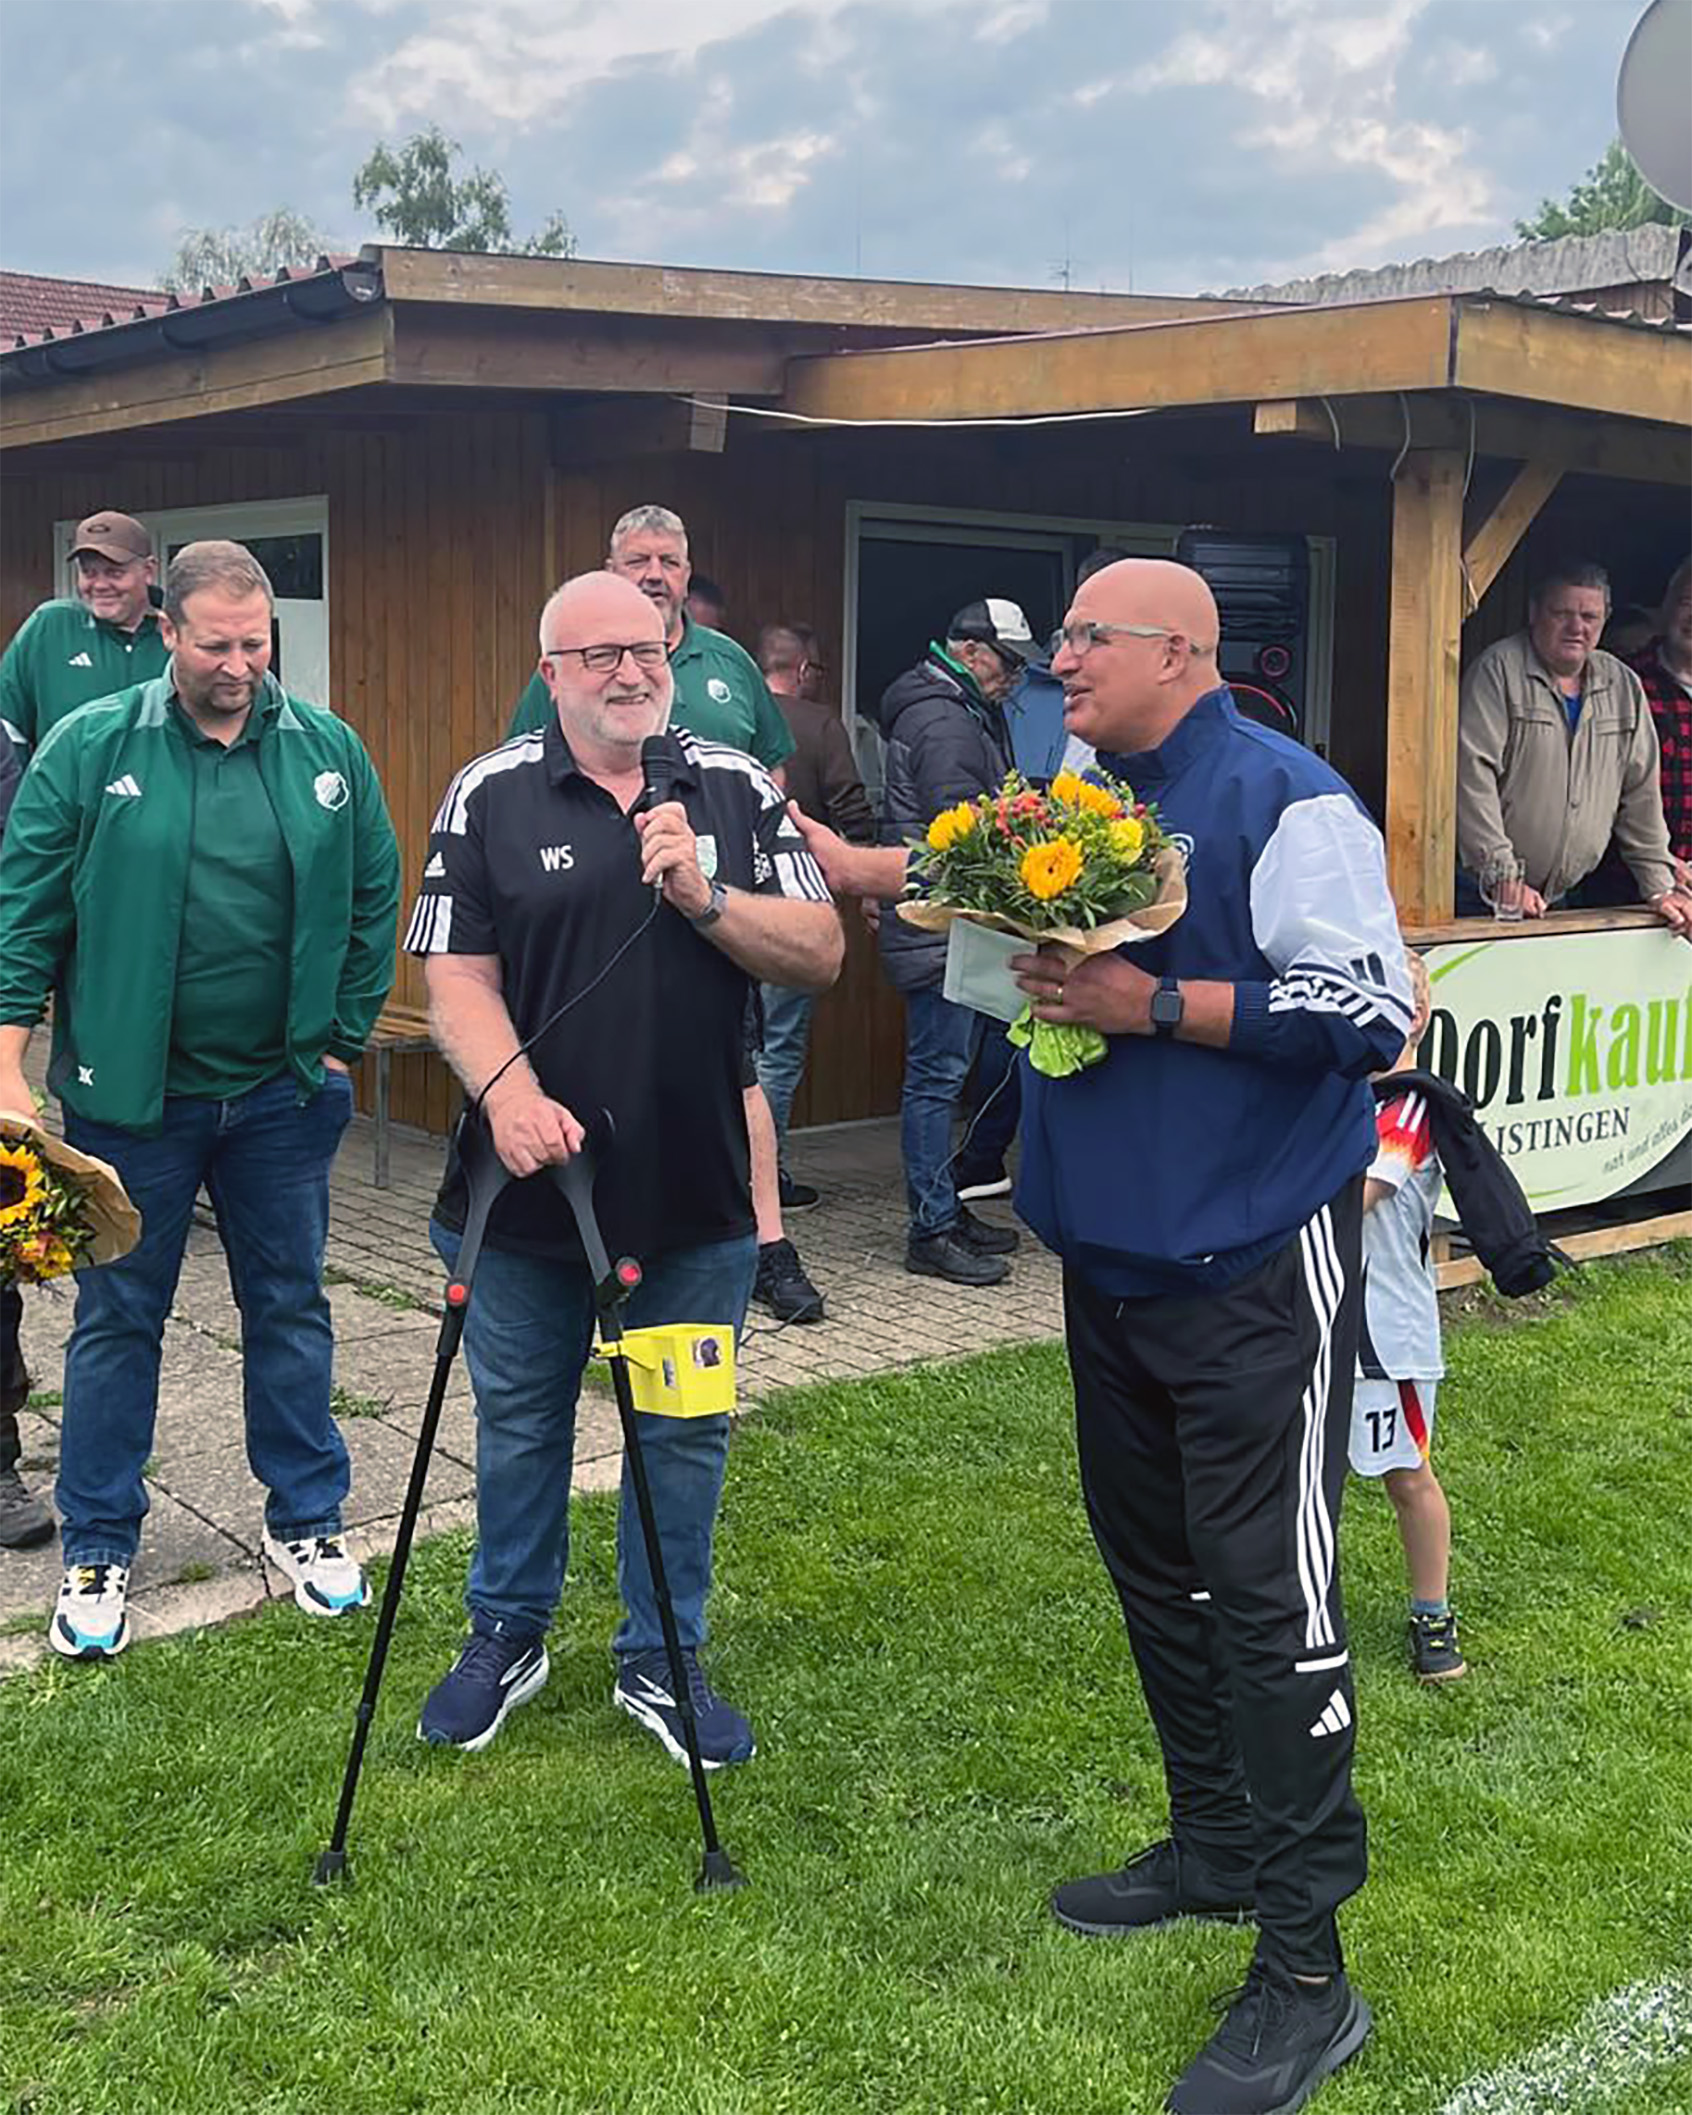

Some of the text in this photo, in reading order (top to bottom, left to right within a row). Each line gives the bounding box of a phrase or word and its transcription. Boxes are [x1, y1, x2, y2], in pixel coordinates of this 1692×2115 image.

[540, 844, 574, 872] WS
[1480, 1106, 1629, 1156] ISTINGEN
[1365, 1408, 1397, 1453] 13
